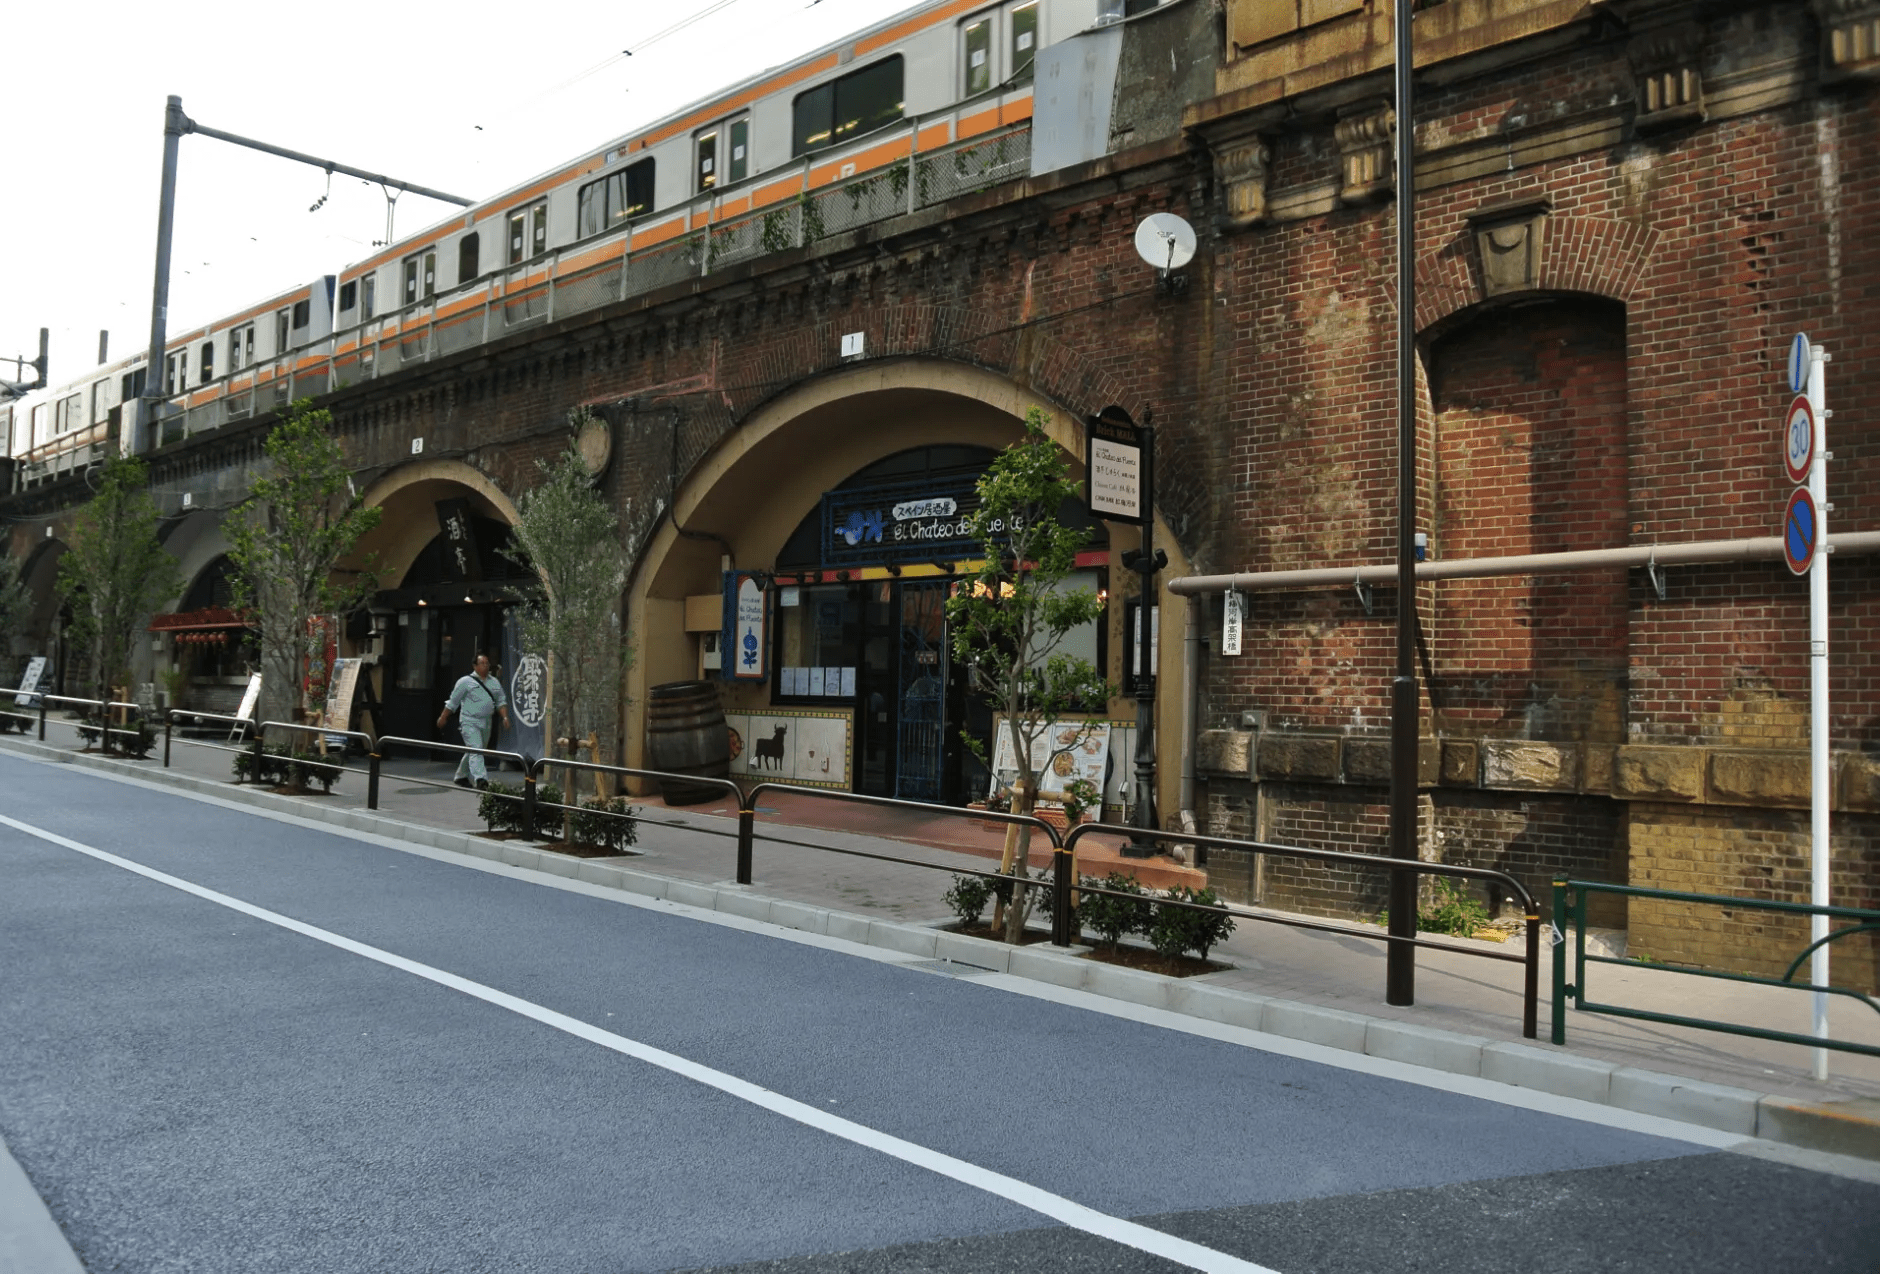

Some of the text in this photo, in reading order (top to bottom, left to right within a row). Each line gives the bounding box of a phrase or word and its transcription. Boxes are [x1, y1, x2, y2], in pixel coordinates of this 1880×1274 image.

[1791, 419, 1808, 459] 30
[898, 502, 951, 517] スペイン居酒屋
[910, 518, 954, 539] Chateo
